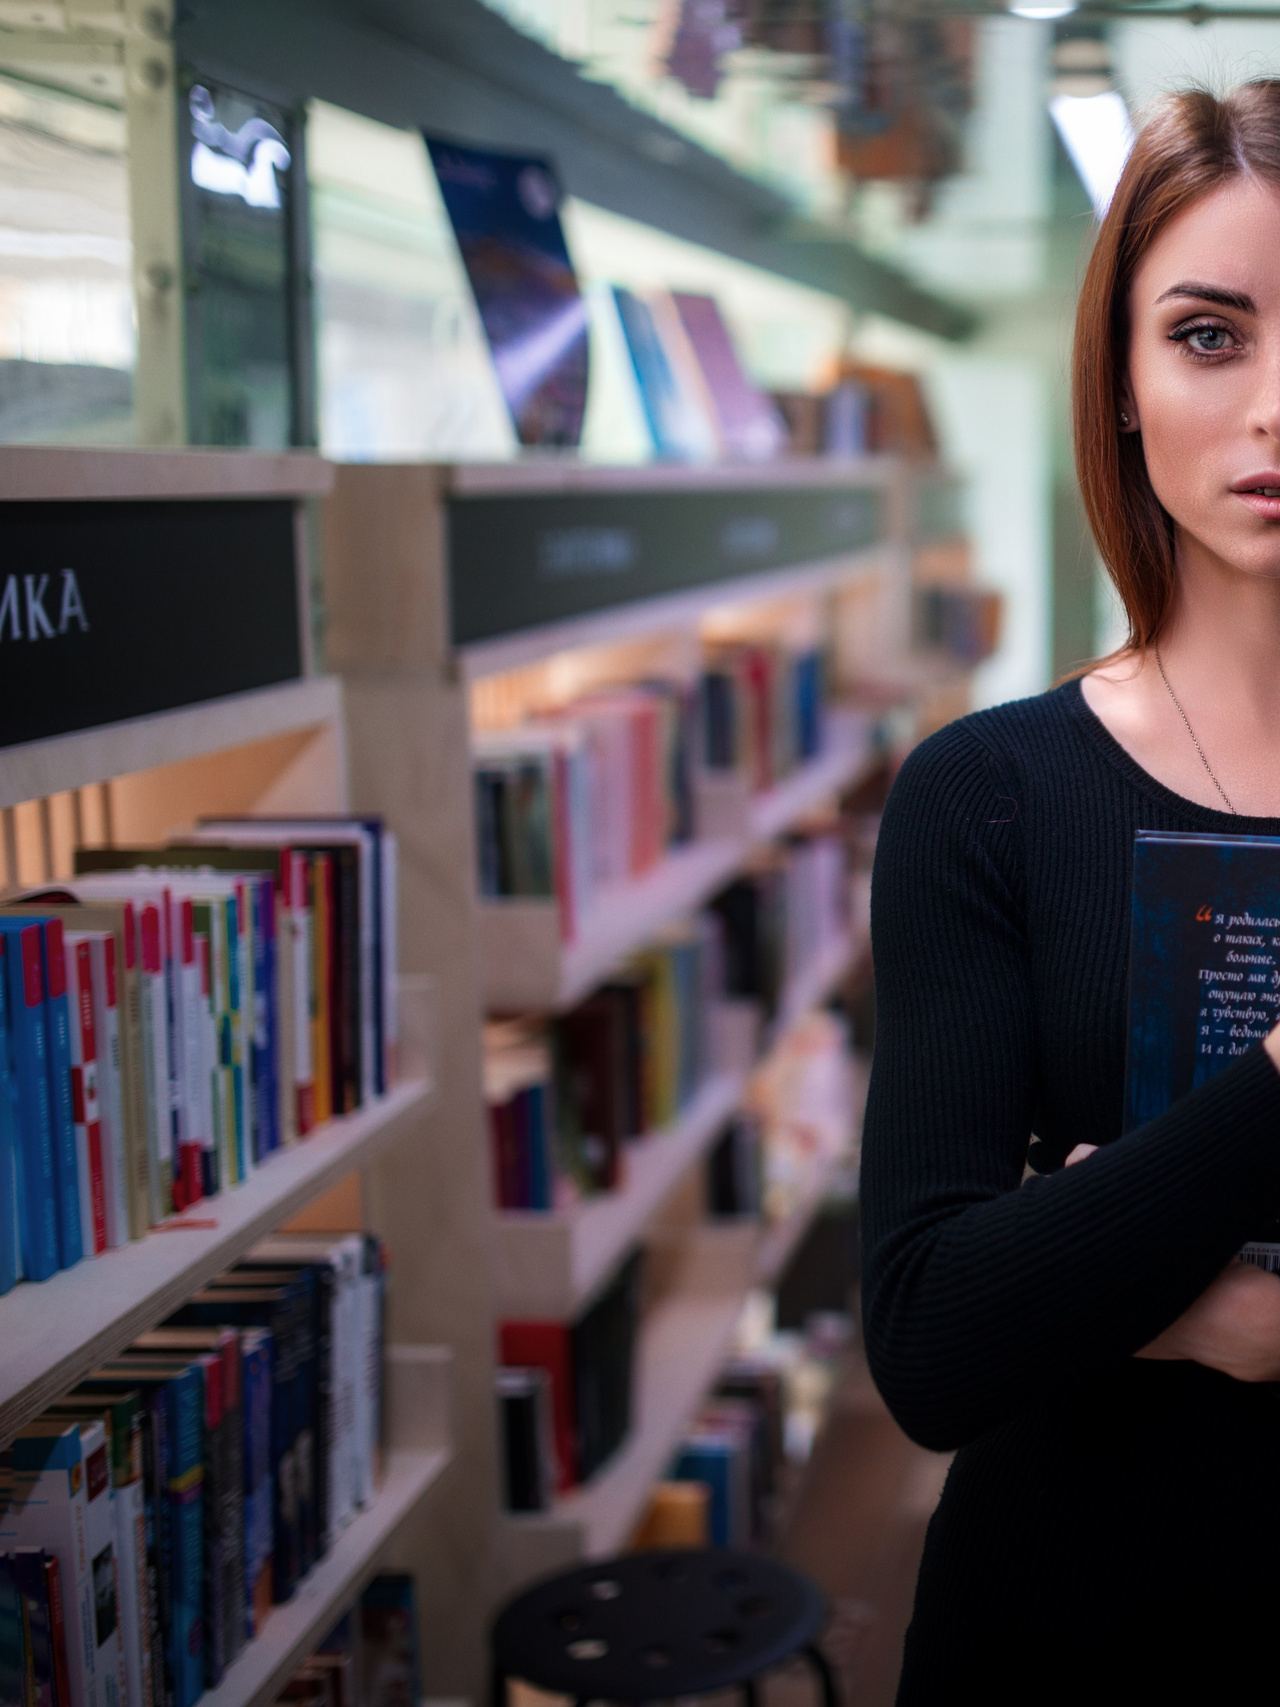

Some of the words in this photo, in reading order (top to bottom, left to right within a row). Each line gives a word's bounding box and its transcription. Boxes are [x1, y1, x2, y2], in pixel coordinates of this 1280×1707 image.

[1214, 914, 1224, 924] Я
[1227, 912, 1280, 929] родилась
[1213, 934, 1221, 943] о
[1225, 934, 1266, 948] таких,
[1226, 950, 1276, 965] больные.
[1198, 969, 1244, 984] Просто
[1248, 973, 1266, 982] мы
[1208, 990, 1256, 1004] ощущаю
[1200, 1008, 1208, 1016] я
[1212, 1006, 1270, 1024] чувствую,
[1200, 1025, 1210, 1035] Я
[1230, 1024, 1269, 1038] ведьма
[1201, 1044, 1212, 1054] И
[1216, 1045, 1224, 1055] я
